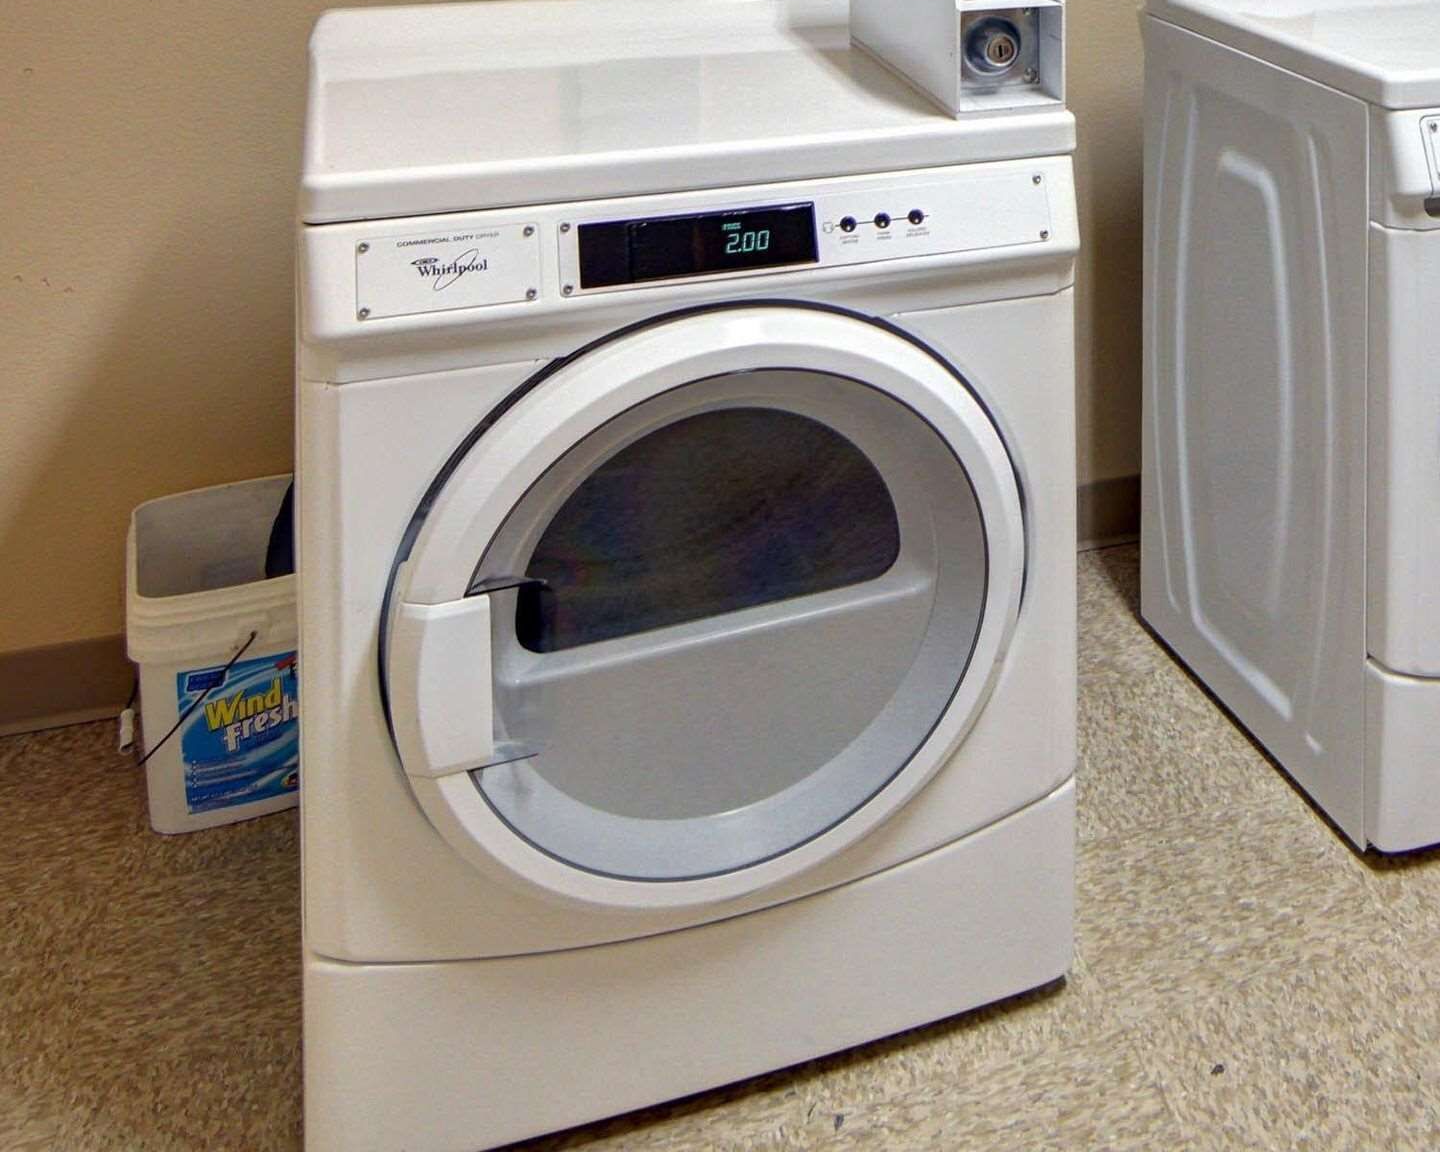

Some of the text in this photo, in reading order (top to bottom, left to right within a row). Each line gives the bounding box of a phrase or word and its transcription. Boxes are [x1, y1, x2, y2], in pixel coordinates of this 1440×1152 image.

[396, 237, 450, 248] COMMERCIAL
[453, 234, 473, 242] DUTY
[726, 230, 770, 254] 2.00
[416, 258, 488, 279] Whirlpool
[204, 676, 283, 732] Wind
[223, 694, 298, 752] Fresh
